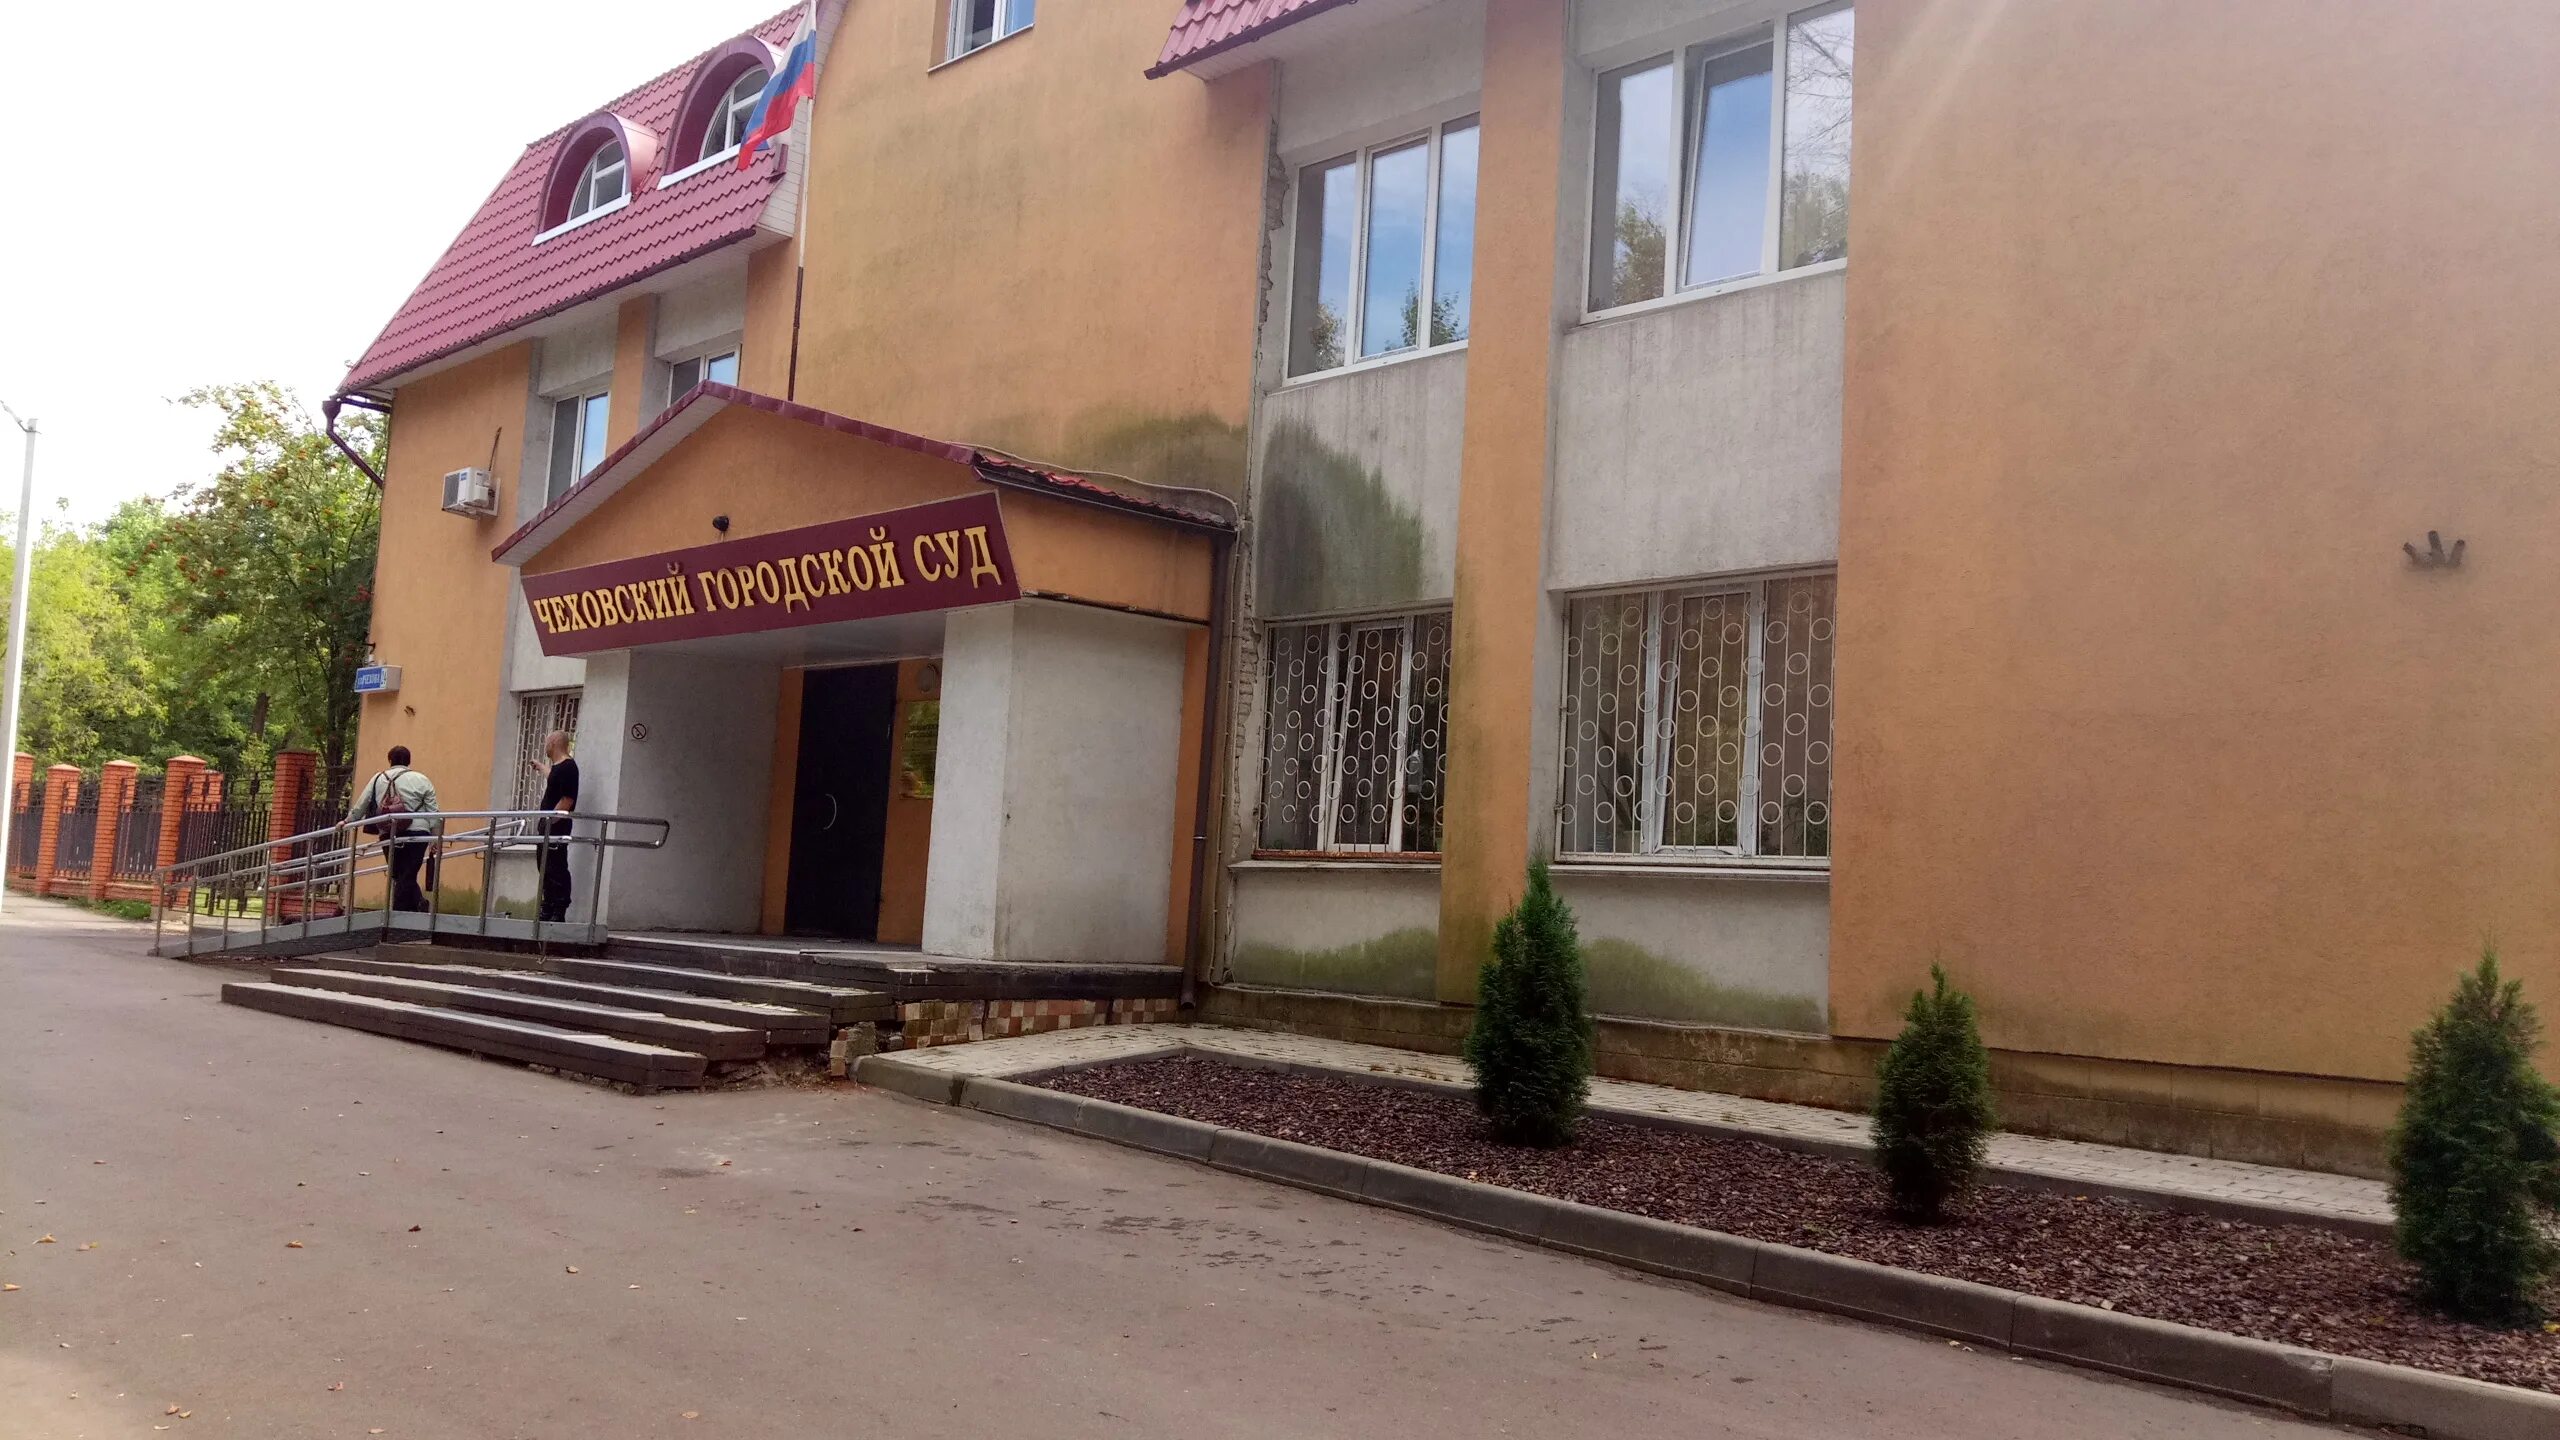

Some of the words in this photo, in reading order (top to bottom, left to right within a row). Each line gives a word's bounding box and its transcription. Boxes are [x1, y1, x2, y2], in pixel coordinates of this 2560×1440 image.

[533, 562, 696, 634] ЧЕХОВСКИЙ
[697, 526, 905, 614] ГОРОДСКОЙ
[913, 525, 1002, 589] СУД
